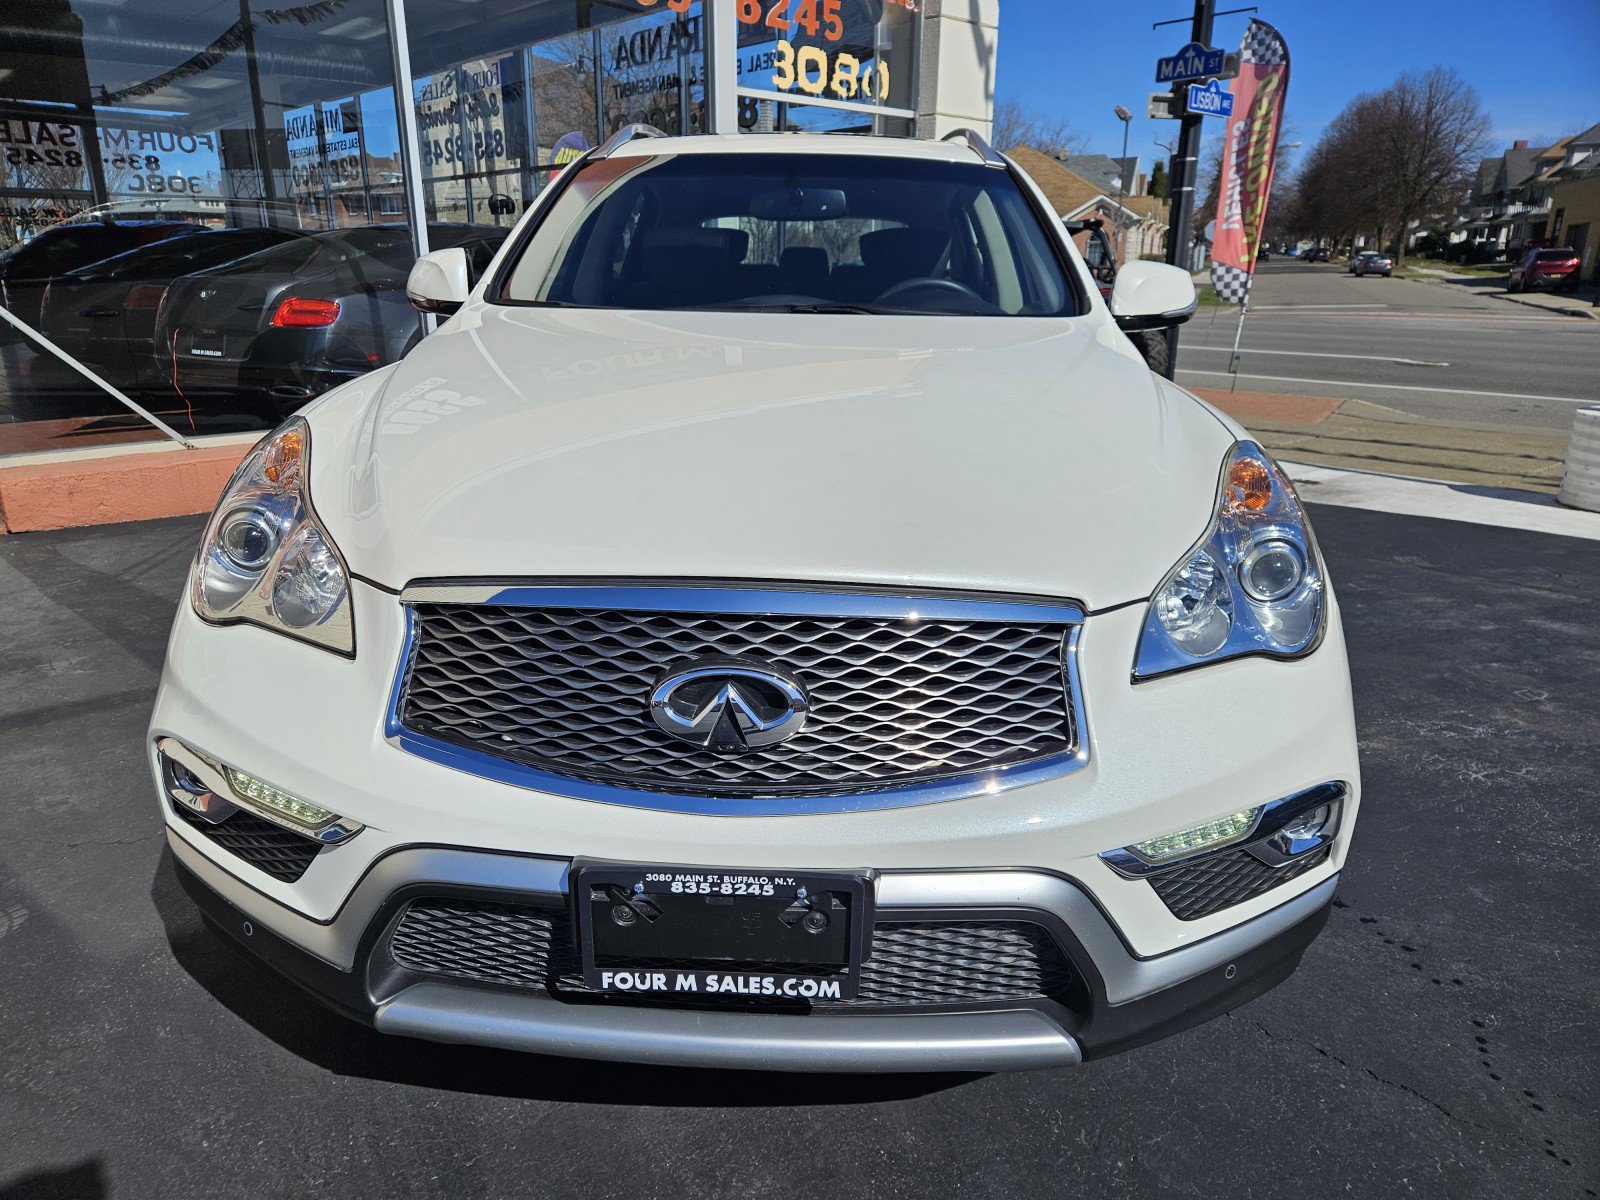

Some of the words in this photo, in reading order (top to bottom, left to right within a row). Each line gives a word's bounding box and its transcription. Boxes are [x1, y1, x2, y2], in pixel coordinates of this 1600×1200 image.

[1161, 57, 1205, 78] MAIN
[1209, 58, 1219, 67] ST
[1191, 88, 1221, 111] LISBON
[646, 873, 672, 882] 3080
[675, 874, 704, 883] MAIN
[707, 875, 721, 883] ST.
[723, 875, 771, 885] BUFFALO,
[774, 877, 796, 886] N.Y.
[671, 881, 775, 896] 835-8245
[602, 971, 668, 991] FOUR
[675, 973, 698, 992] M
[705, 974, 841, 999] SALES.COM
